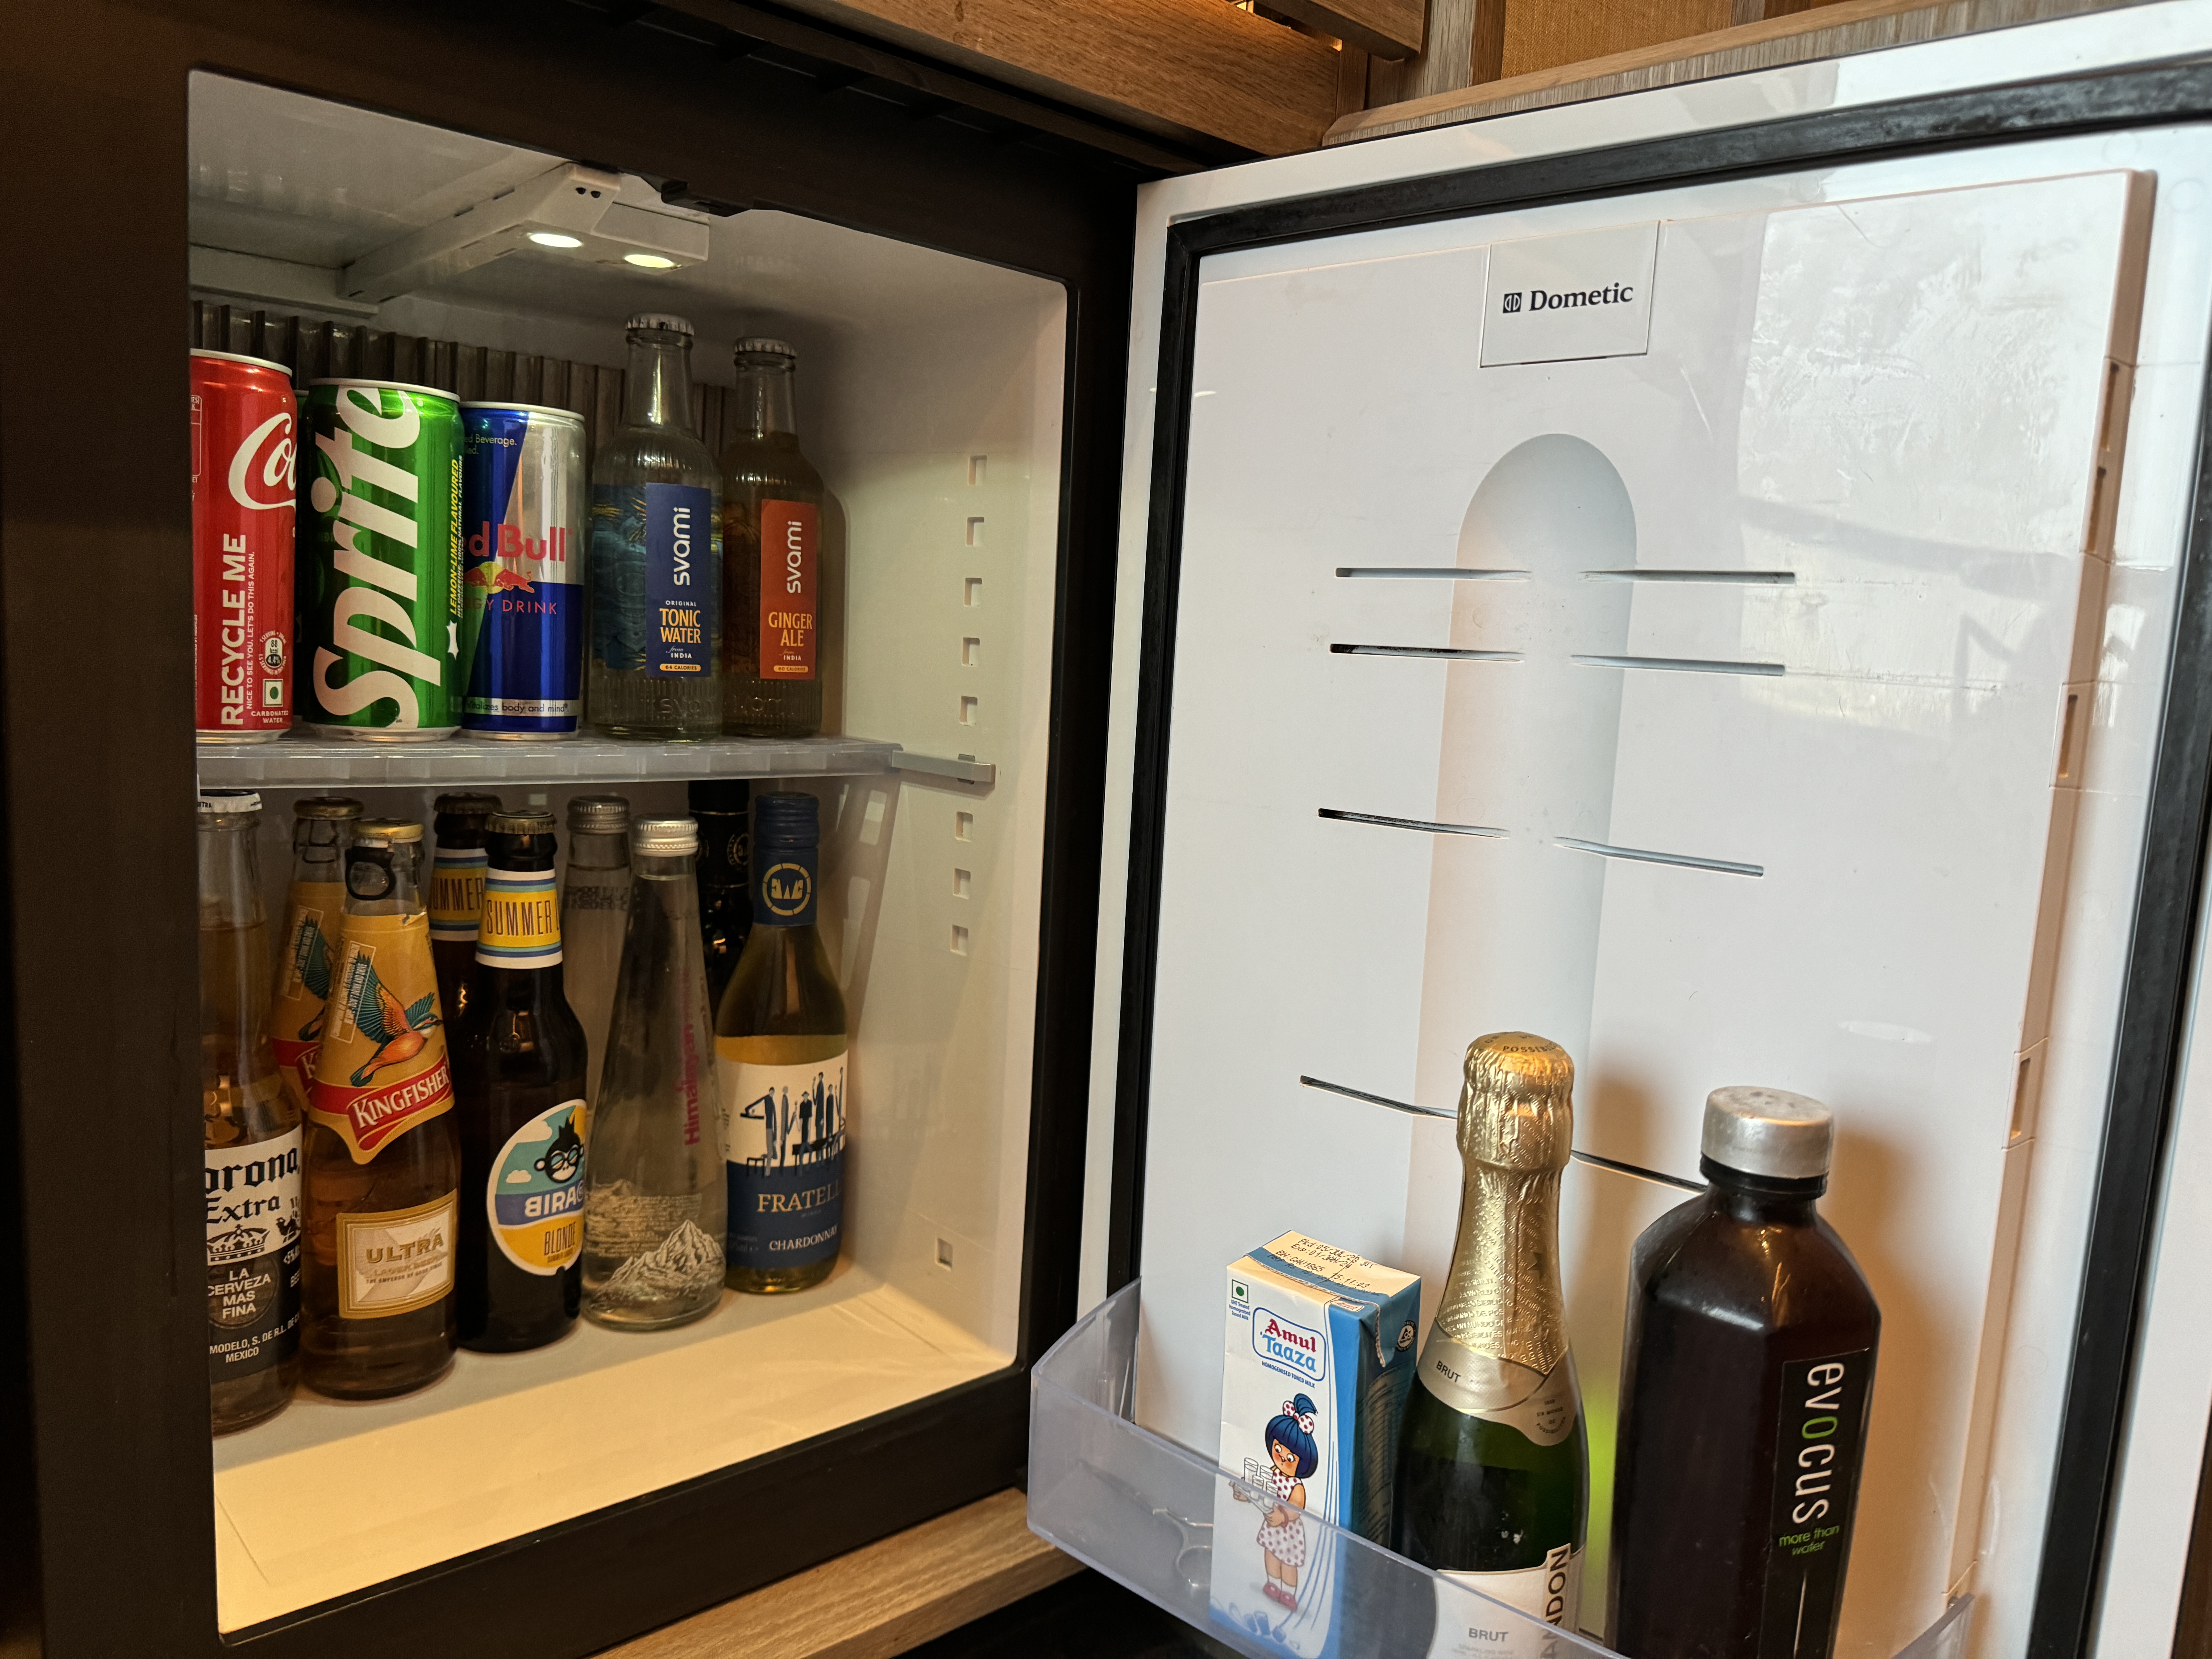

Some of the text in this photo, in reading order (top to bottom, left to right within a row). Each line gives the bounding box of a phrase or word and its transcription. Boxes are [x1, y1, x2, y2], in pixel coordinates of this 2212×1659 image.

[1529, 282, 1633, 311] Dometic
[475, 434, 517, 448] Beverage.
[451, 459, 459, 534] FLAVOURED
[498, 524, 565, 562] Bull
[673, 507, 690, 586] svami
[312, 388, 441, 729] Sprite
[787, 520, 802, 594] svami
[247, 601, 254, 614] DO
[502, 599, 557, 615] DRINK
[659, 608, 701, 627] TONIC
[221, 533, 246, 725] RECYCLE ME
[768, 611, 812, 629] GINGER
[660, 627, 701, 644] WATER
[780, 629, 804, 647] ALE
[247, 677, 253, 689] TO
[502, 703, 525, 713] body
[528, 703, 544, 712] and
[487, 900, 552, 936] SUMMER
[352, 1065, 450, 1129] KINGFISHER
[205, 1148, 297, 1195] orona
[206, 1196, 280, 1224] Extra
[366, 1233, 444, 1263] ULTRA
[769, 1224, 838, 1251] CHARDONNAY
[229, 1268, 250, 1281] LA
[223, 1290, 256, 1307] MAS
[223, 1302, 256, 1319] FINA
[210, 1339, 250, 1354] MODELO,
[262, 1330, 273, 1343] DE
[1265, 1318, 1316, 1353] Amul
[225, 1346, 259, 1363] MEXICO
[1262, 1334, 1316, 1372] Taaza
[1262, 1360, 1316, 1389] HOMOGENISED TONED MILK
[1436, 1360, 1462, 1383] BRUT
[1792, 1362, 1845, 1524] evocus
[1779, 1525, 1841, 1547] more than
[1791, 1540, 1826, 1556] water
[1468, 1627, 1509, 1642] BRUT
